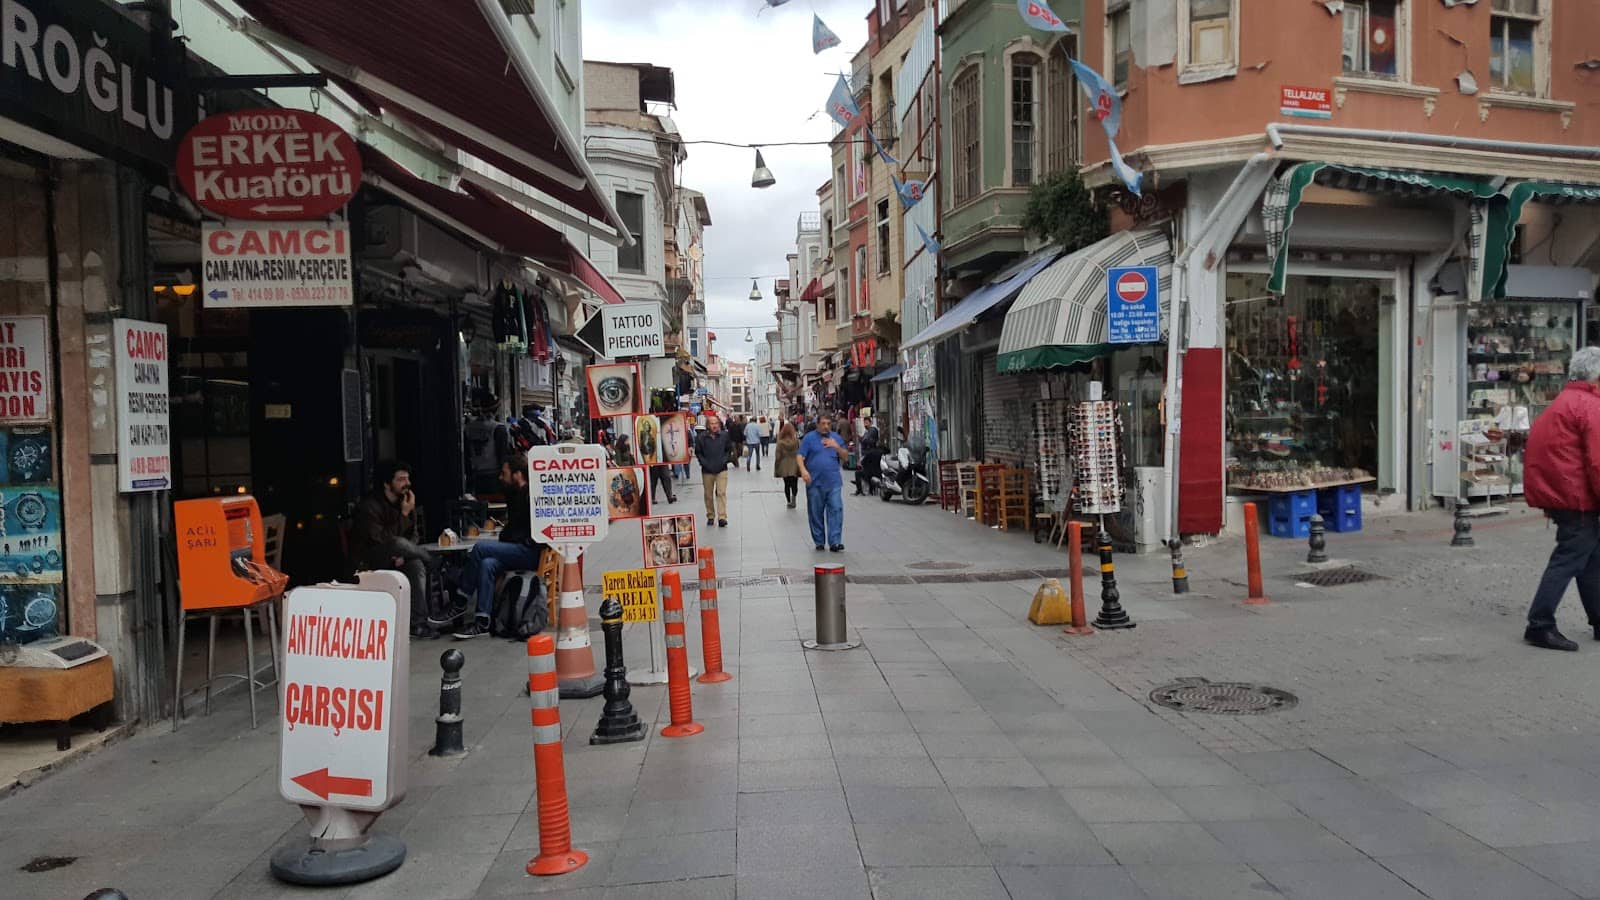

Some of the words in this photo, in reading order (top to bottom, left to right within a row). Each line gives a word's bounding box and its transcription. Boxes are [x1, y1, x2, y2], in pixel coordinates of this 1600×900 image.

[2, 0, 173, 139] ROĞLU
[1283, 88, 1326, 101] TELLALZADE
[229, 115, 302, 131] MODA
[192, 130, 345, 166] ERKEK
[194, 167, 352, 201] Kuaförü
[208, 229, 345, 255] CAMCI
[612, 314, 653, 330] TATTOO
[127, 329, 165, 360] CAMCI
[608, 334, 659, 349] PIERCING
[532, 458, 600, 471] CAMCI
[557, 496, 572, 506] CAM
[574, 495, 601, 505] BALKON
[604, 575, 626, 591] Yaren
[627, 571, 655, 589] Reklam
[288, 606, 388, 660] ANTİKACILAR
[285, 682, 384, 736] ÇARŞISI
